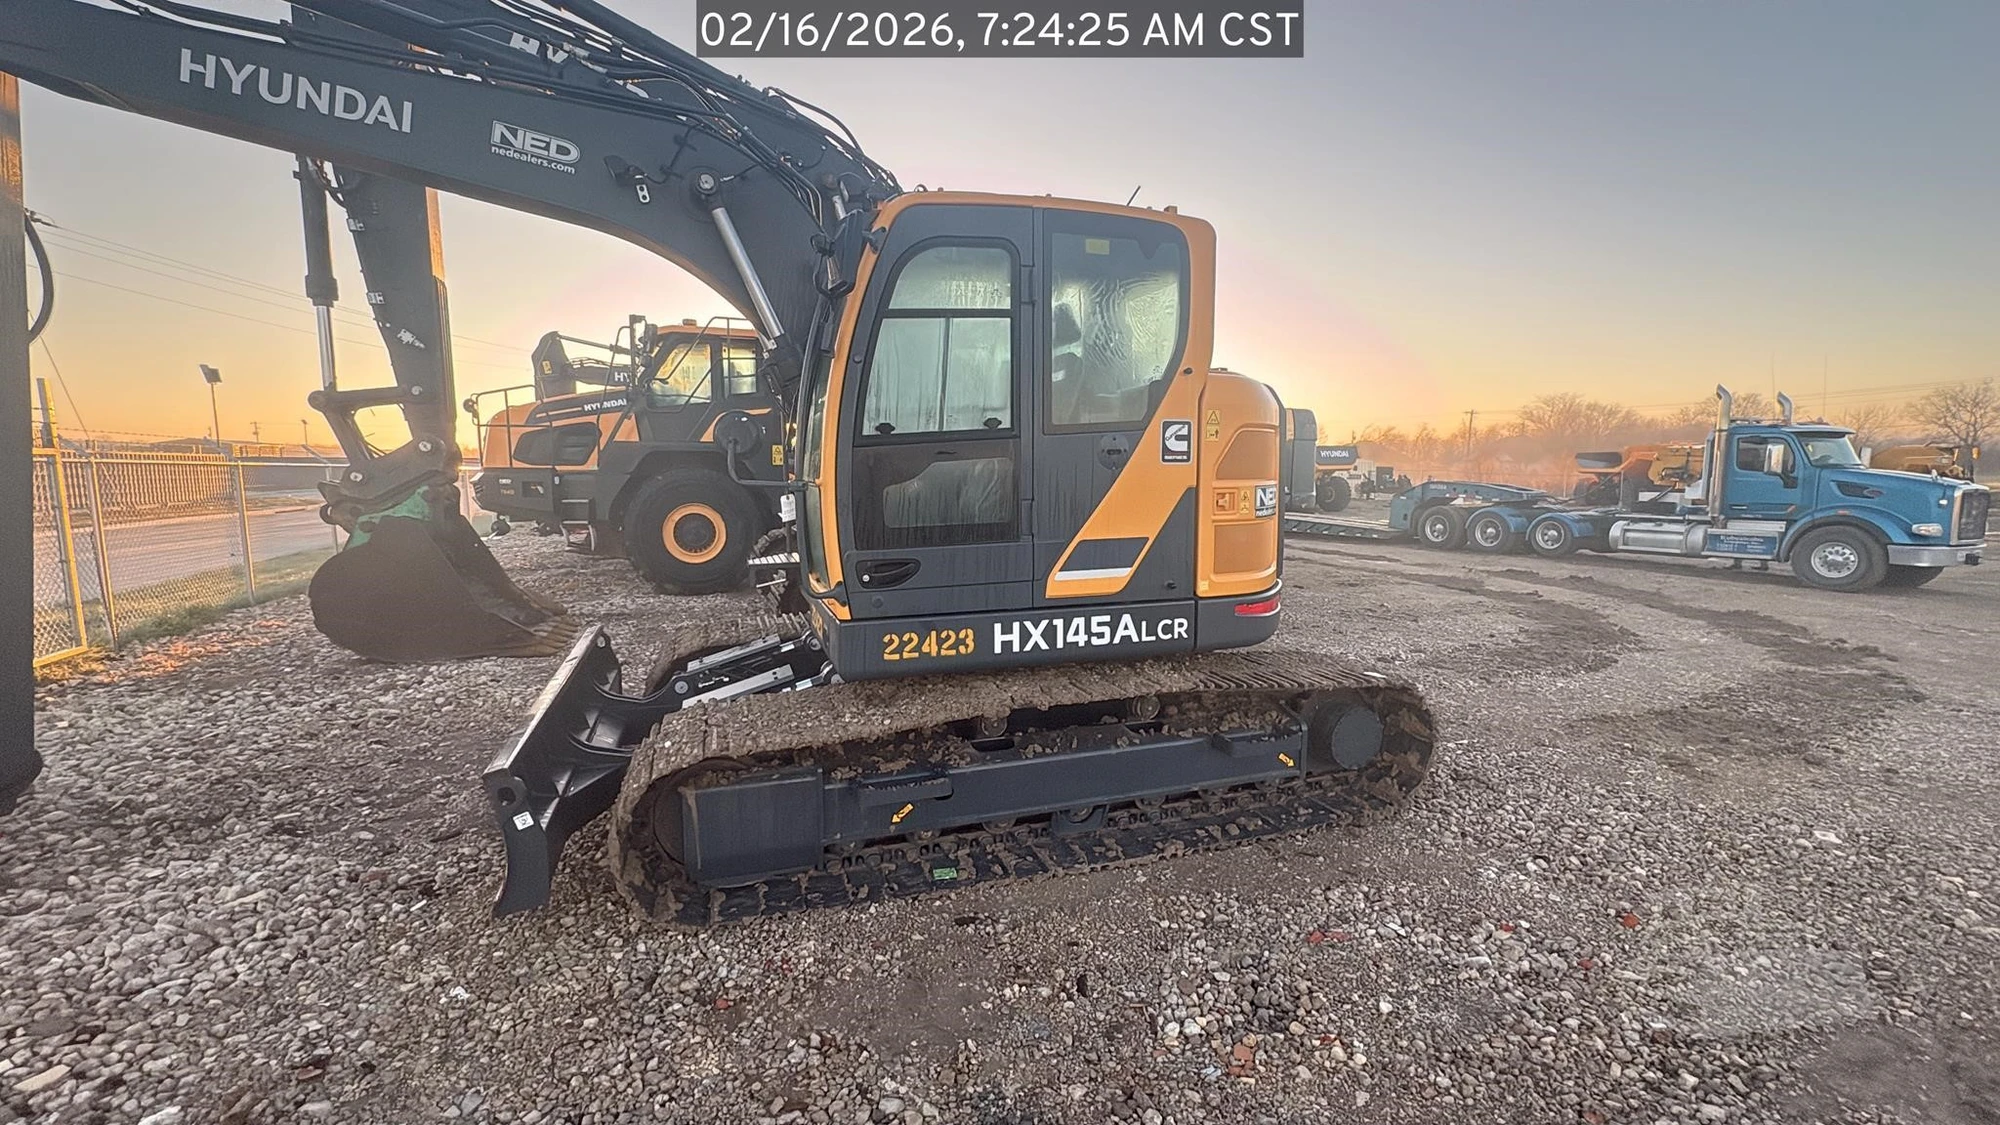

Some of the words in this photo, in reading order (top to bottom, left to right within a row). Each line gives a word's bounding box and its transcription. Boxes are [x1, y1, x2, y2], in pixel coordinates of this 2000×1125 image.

[179, 48, 413, 134] HYUNDAI
[493, 122, 578, 161] NED
[491, 145, 576, 175] nedealers.com
[1320, 450, 1349, 458] HYUNDAI
[882, 628, 975, 661] 22423
